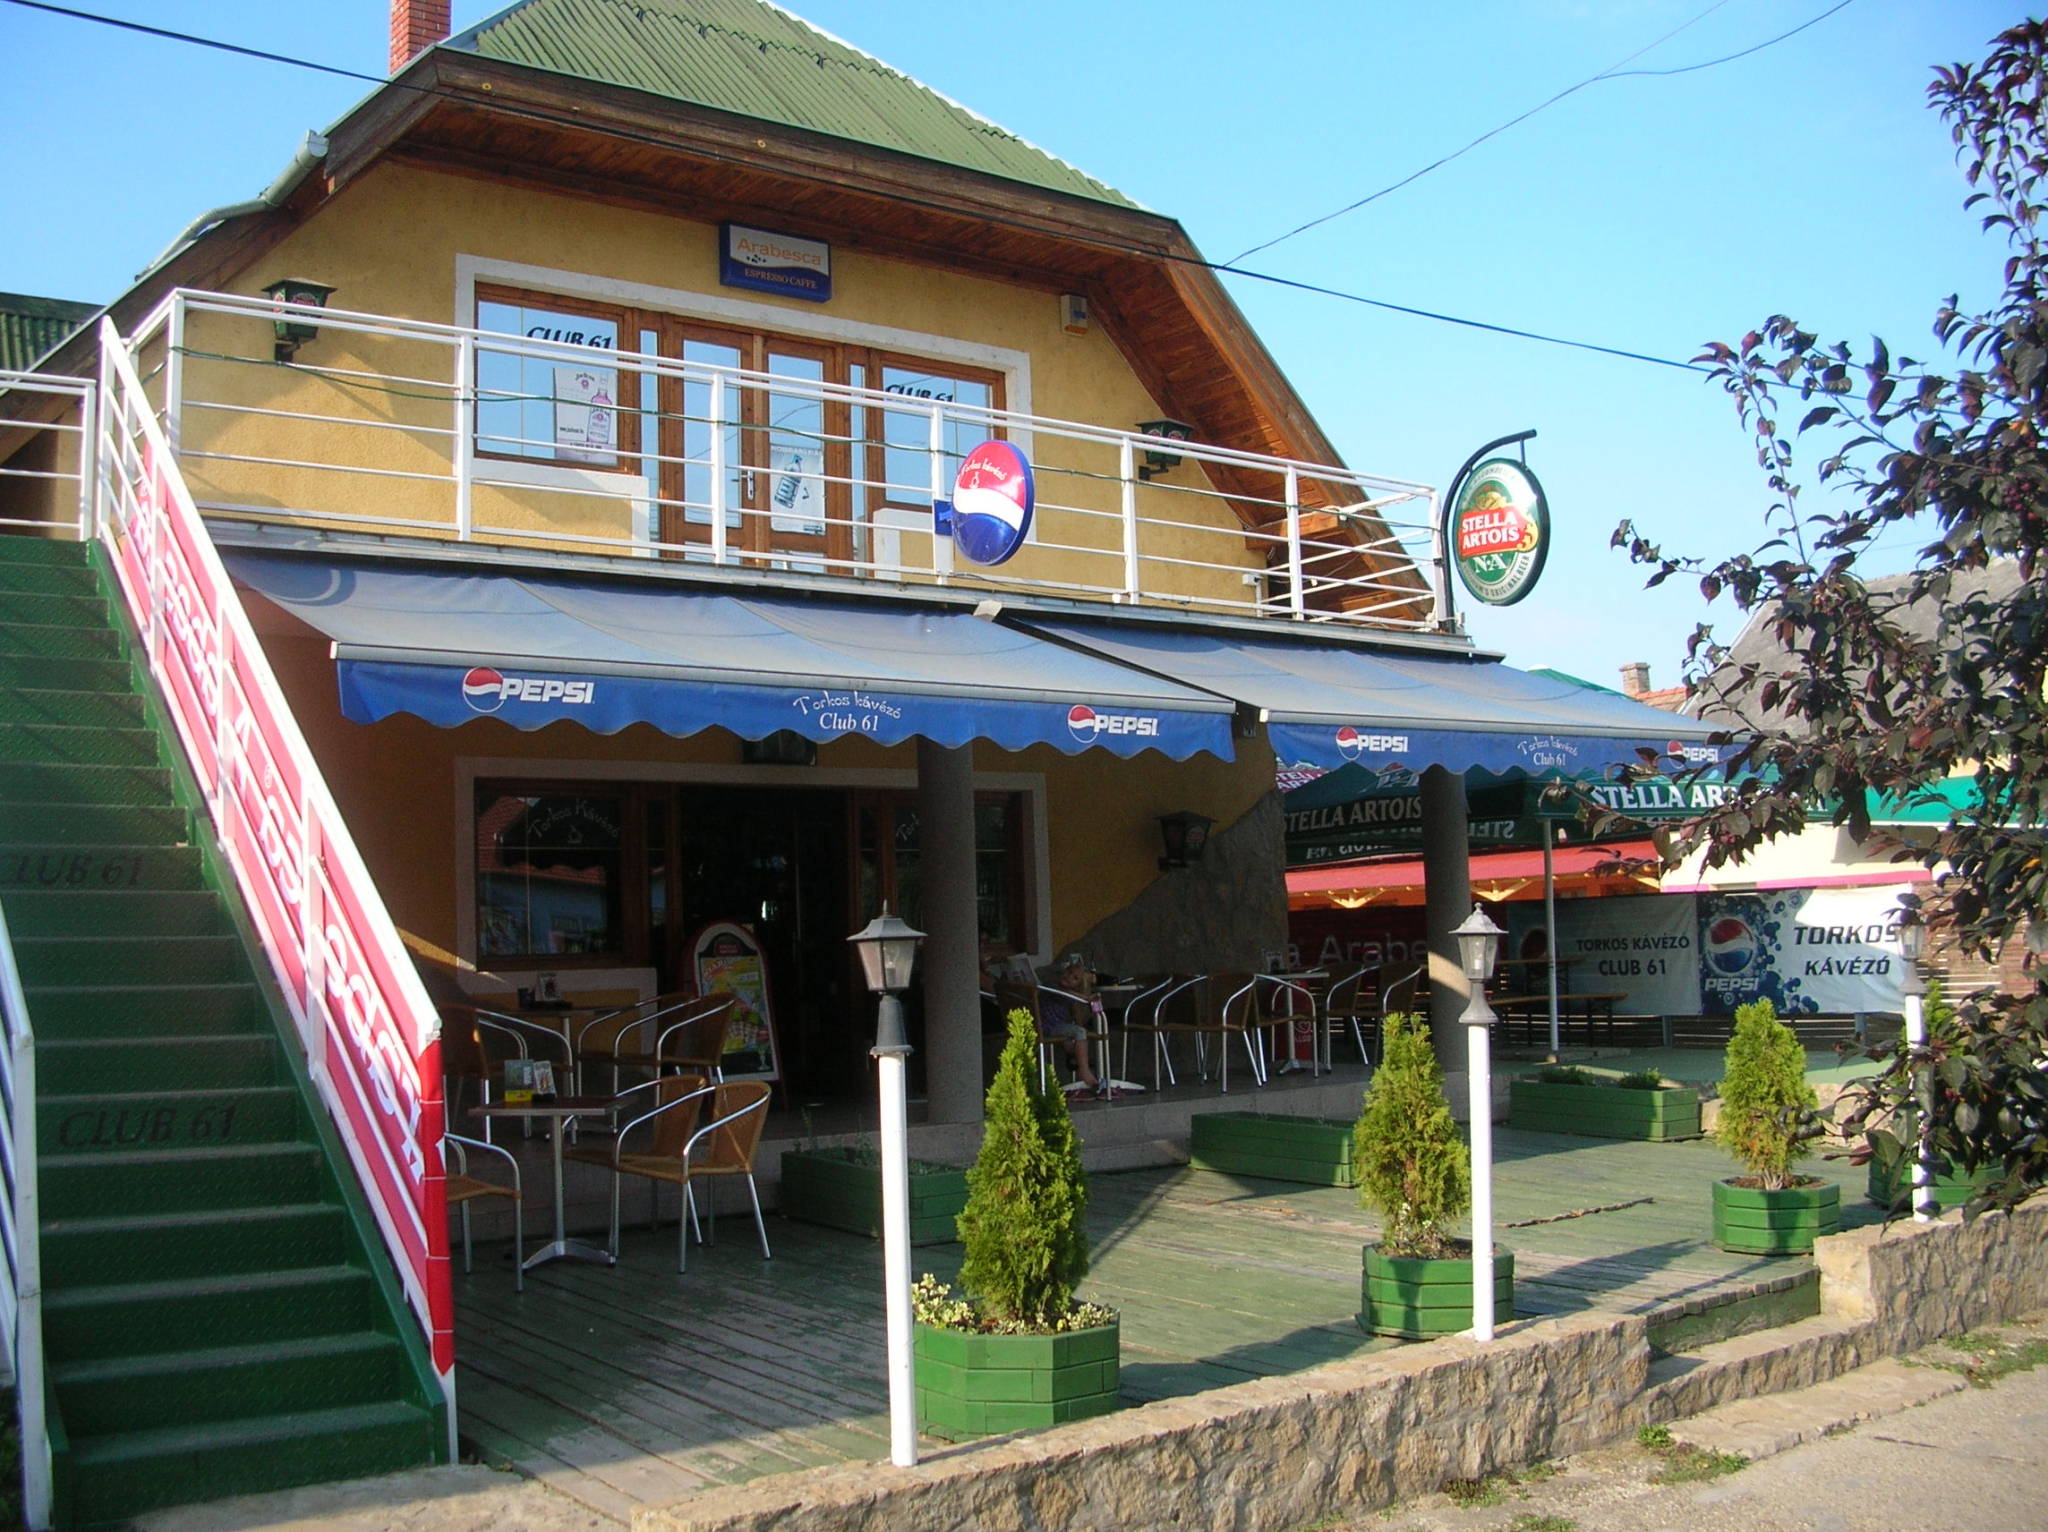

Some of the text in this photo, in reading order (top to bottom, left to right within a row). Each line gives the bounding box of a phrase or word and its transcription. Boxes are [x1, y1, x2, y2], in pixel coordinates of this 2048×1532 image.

[737, 238, 822, 265] Arabesca
[745, 267, 789, 283] ESPRESSO
[1462, 511, 1518, 534] STELLA
[1463, 526, 1521, 550] ARTOIS
[499, 677, 595, 705] PEPSI
[792, 689, 903, 720] Torkos kávézó
[819, 712, 879, 732] Club 61
[1093, 714, 1159, 737] PEPSI
[1357, 734, 1409, 753] PEPSI
[1682, 746, 1719, 763] PEPSI
[1533, 752, 1555, 766] Club
[1591, 784, 1686, 810] STELLA
[1349, 795, 1423, 826] ARTOIS
[1576, 932, 1690, 952] TORKOS KÁVÉZÓ
[1793, 924, 1900, 946] TORKOS
[1598, 957, 1667, 977] CLUB 61
[1804, 954, 1891, 977] KÁVÉZÓ
[1704, 976, 1759, 993] PEPSI
[58, 1106, 177, 1148] CLUB
